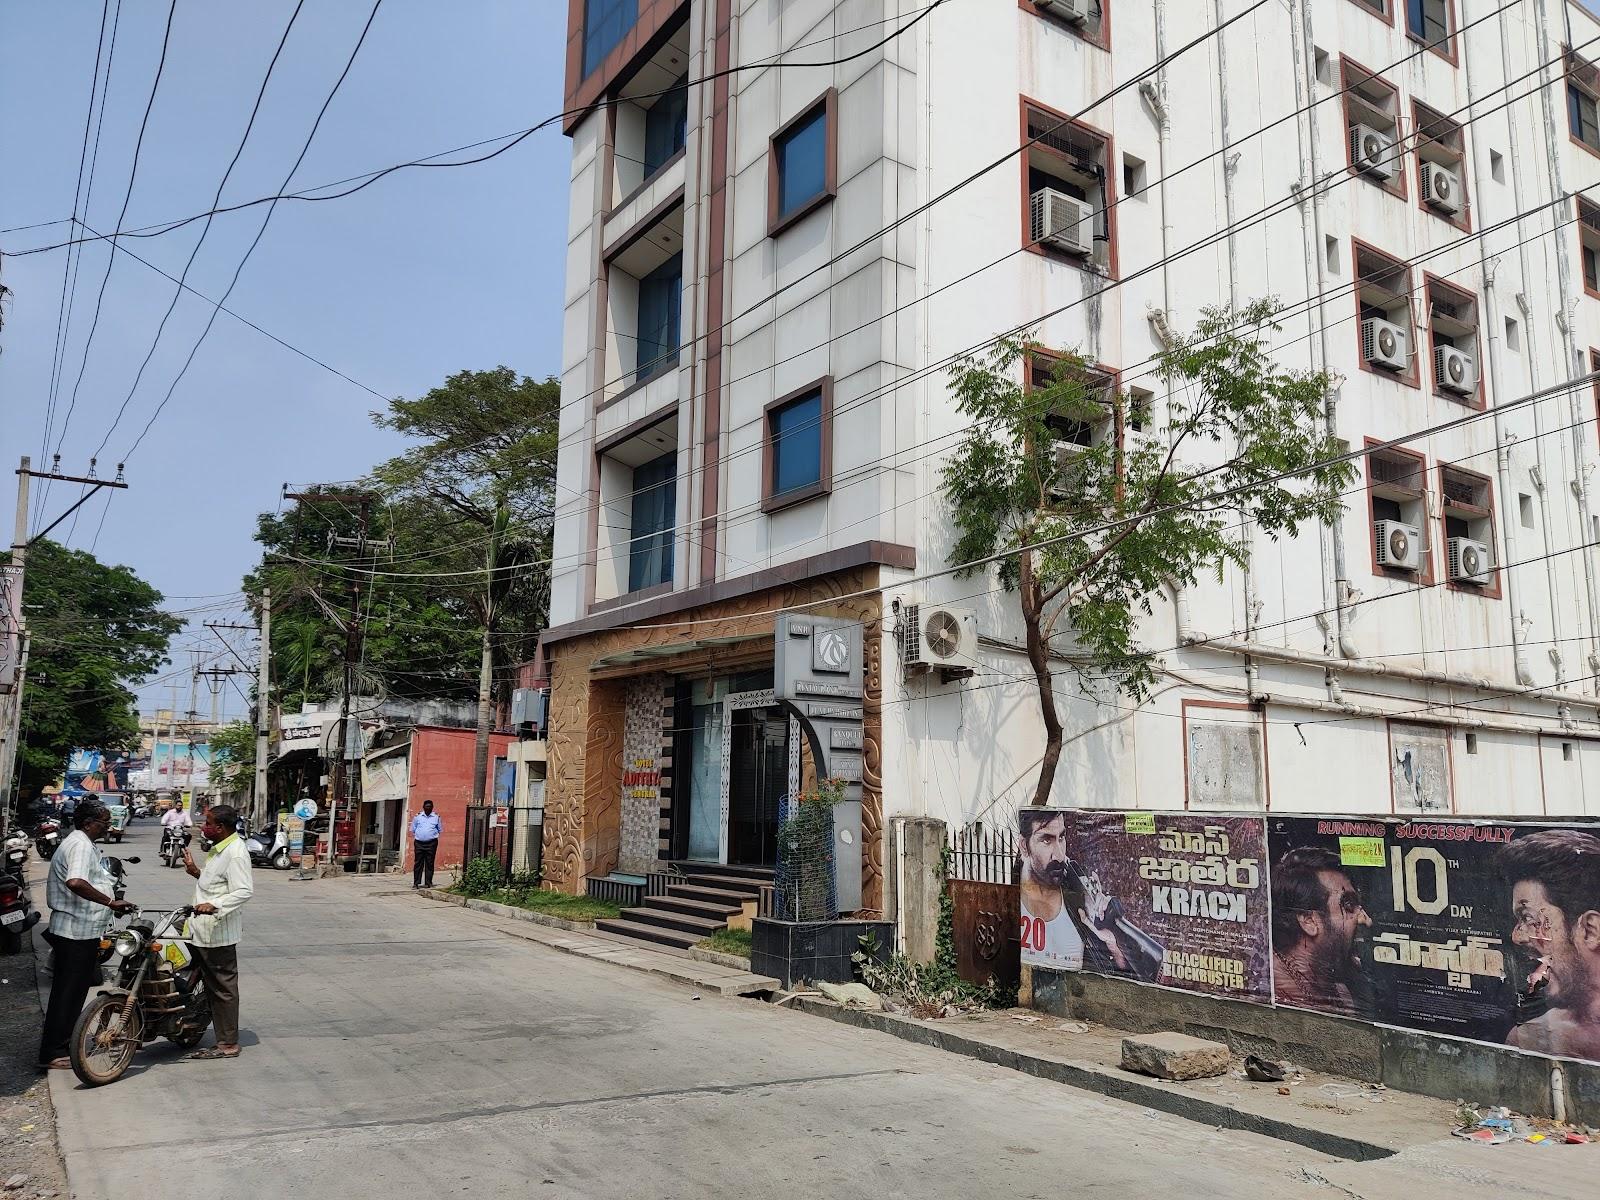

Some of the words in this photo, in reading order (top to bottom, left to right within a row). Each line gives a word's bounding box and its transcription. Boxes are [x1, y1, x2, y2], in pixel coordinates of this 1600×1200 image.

[0, 566, 24, 575] THAJI
[1159, 825, 1230, 856] మాస్
[1317, 821, 1386, 837] RUNNING
[1395, 824, 1515, 843] SUCCESSFULLY
[1390, 845, 1449, 915] 10
[1447, 859, 1460, 869] TH
[1152, 885, 1247, 923] KRACK
[1450, 904, 1473, 919] DAY
[1020, 915, 1046, 951] 20
[1163, 949, 1244, 975] KRACKIFIED
[1162, 963, 1245, 989] BLOCKBUSTER
